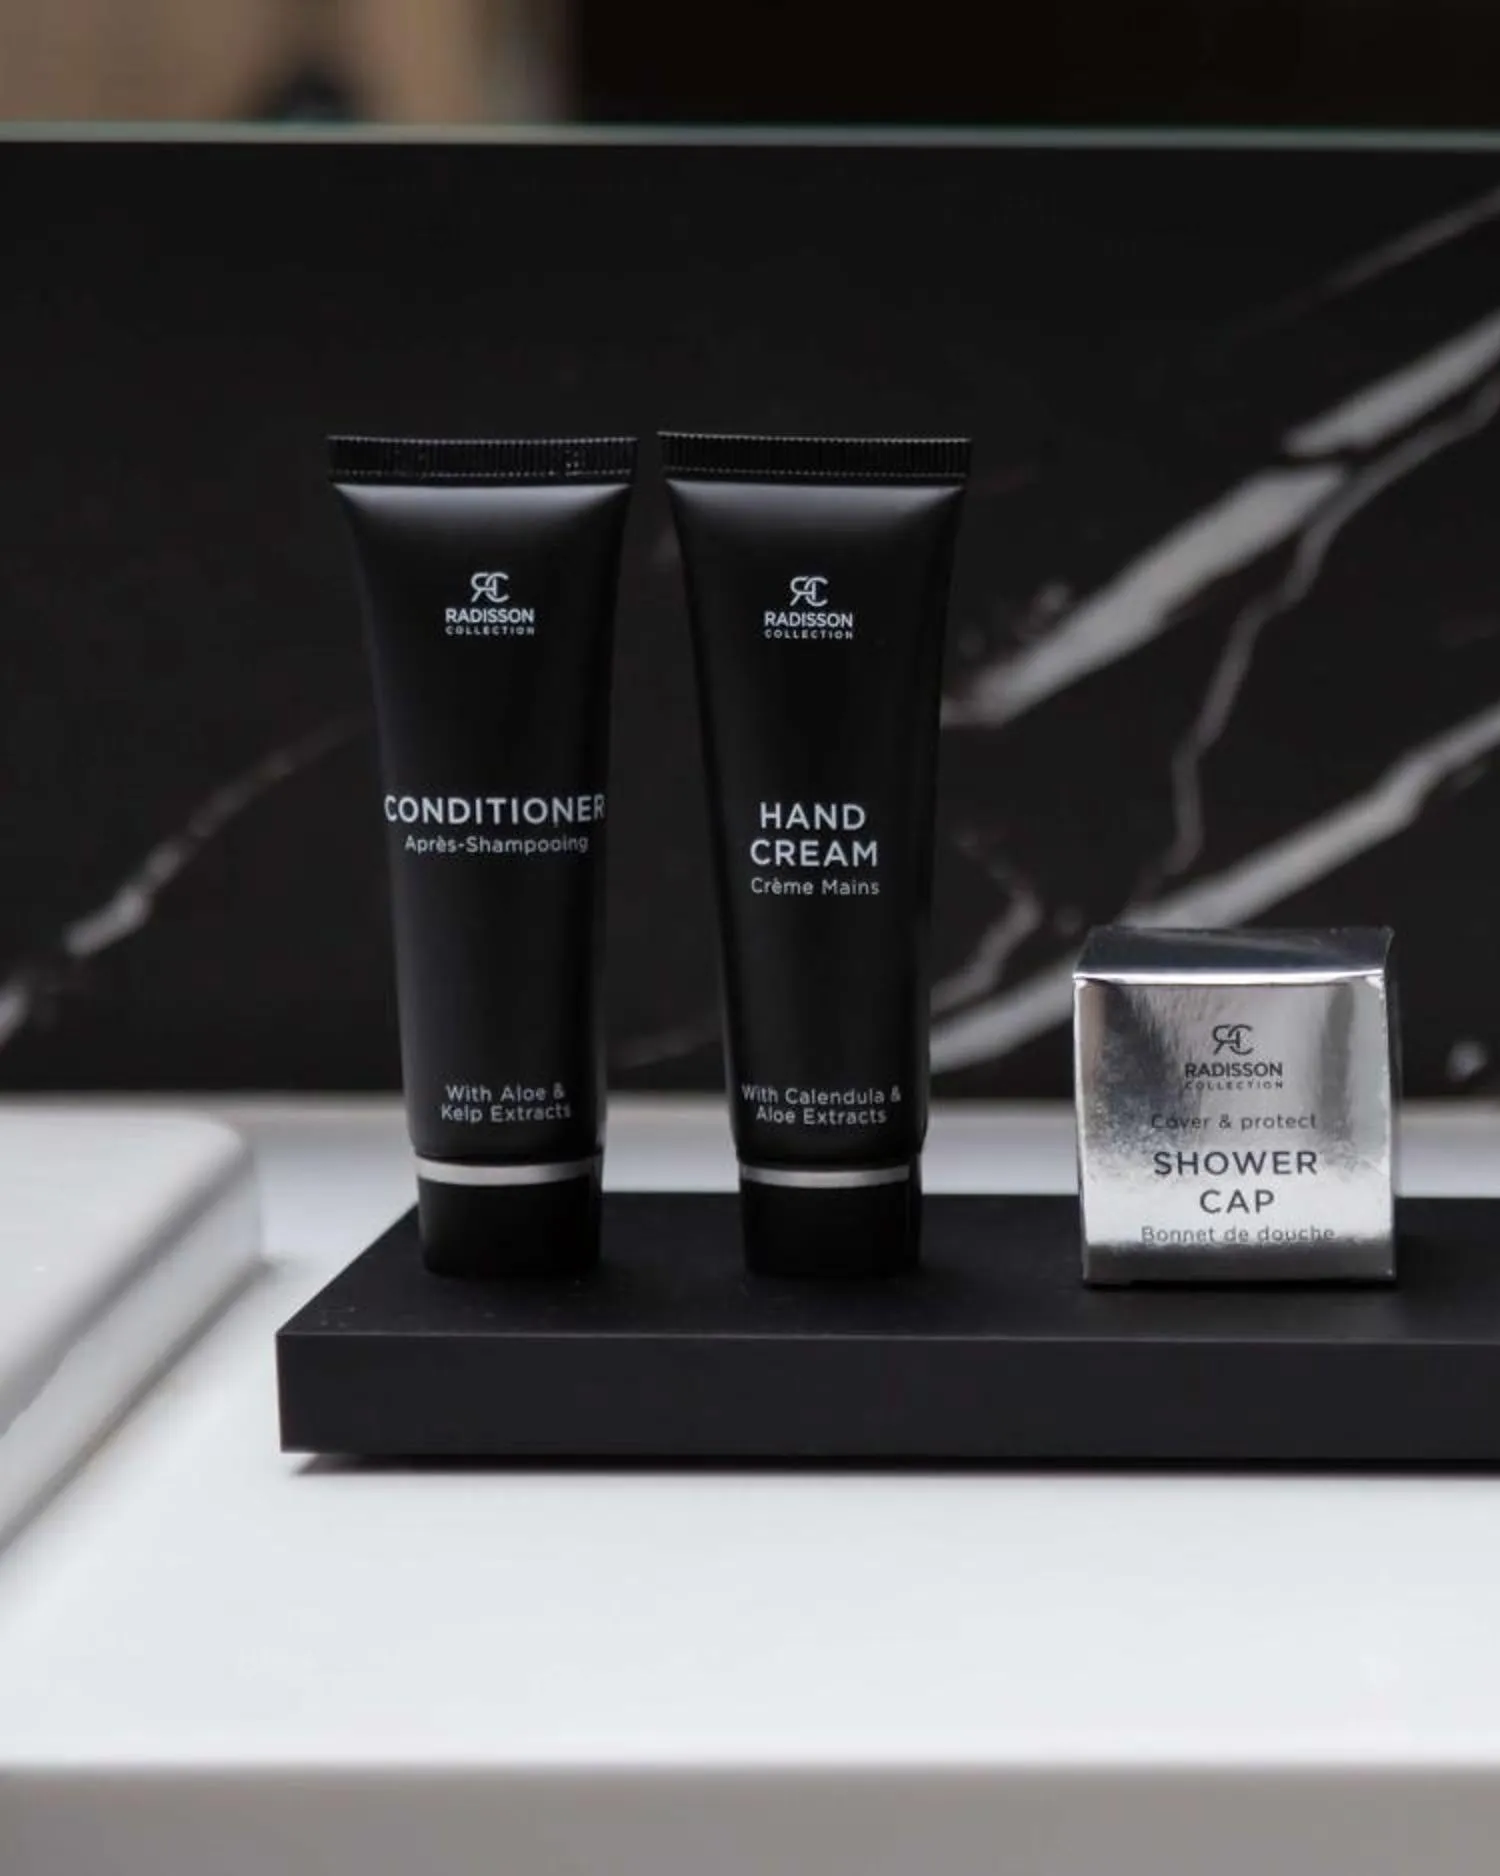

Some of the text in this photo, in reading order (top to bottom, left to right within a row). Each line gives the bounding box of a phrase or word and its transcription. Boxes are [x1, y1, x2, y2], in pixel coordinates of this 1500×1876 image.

[445, 607, 535, 623] RADISSON
[764, 611, 853, 628] RADISSON
[445, 625, 535, 636] COLLECTION
[764, 629, 853, 640] COLLECTION
[384, 794, 605, 825] CONDITIONER
[760, 801, 866, 830] HAND
[404, 834, 589, 855] Après-Shampooing
[750, 838, 878, 868] CREAM
[751, 876, 880, 896] Crème Mains
[1184, 1062, 1283, 1078] RADISSON
[445, 1083, 492, 1103] With
[500, 1082, 546, 1101] Aloe
[741, 1083, 778, 1104] With
[785, 1087, 885, 1105] Calendula
[441, 1102, 571, 1124] Kelp Extracts
[756, 1104, 888, 1126] Aloe Extracts
[1151, 1112, 1317, 1133] Cover & protect
[1153, 1151, 1318, 1176] SHOWER
[1200, 1189, 1275, 1214] CAP
[1141, 1225, 1335, 1243] Bonnet de douche
